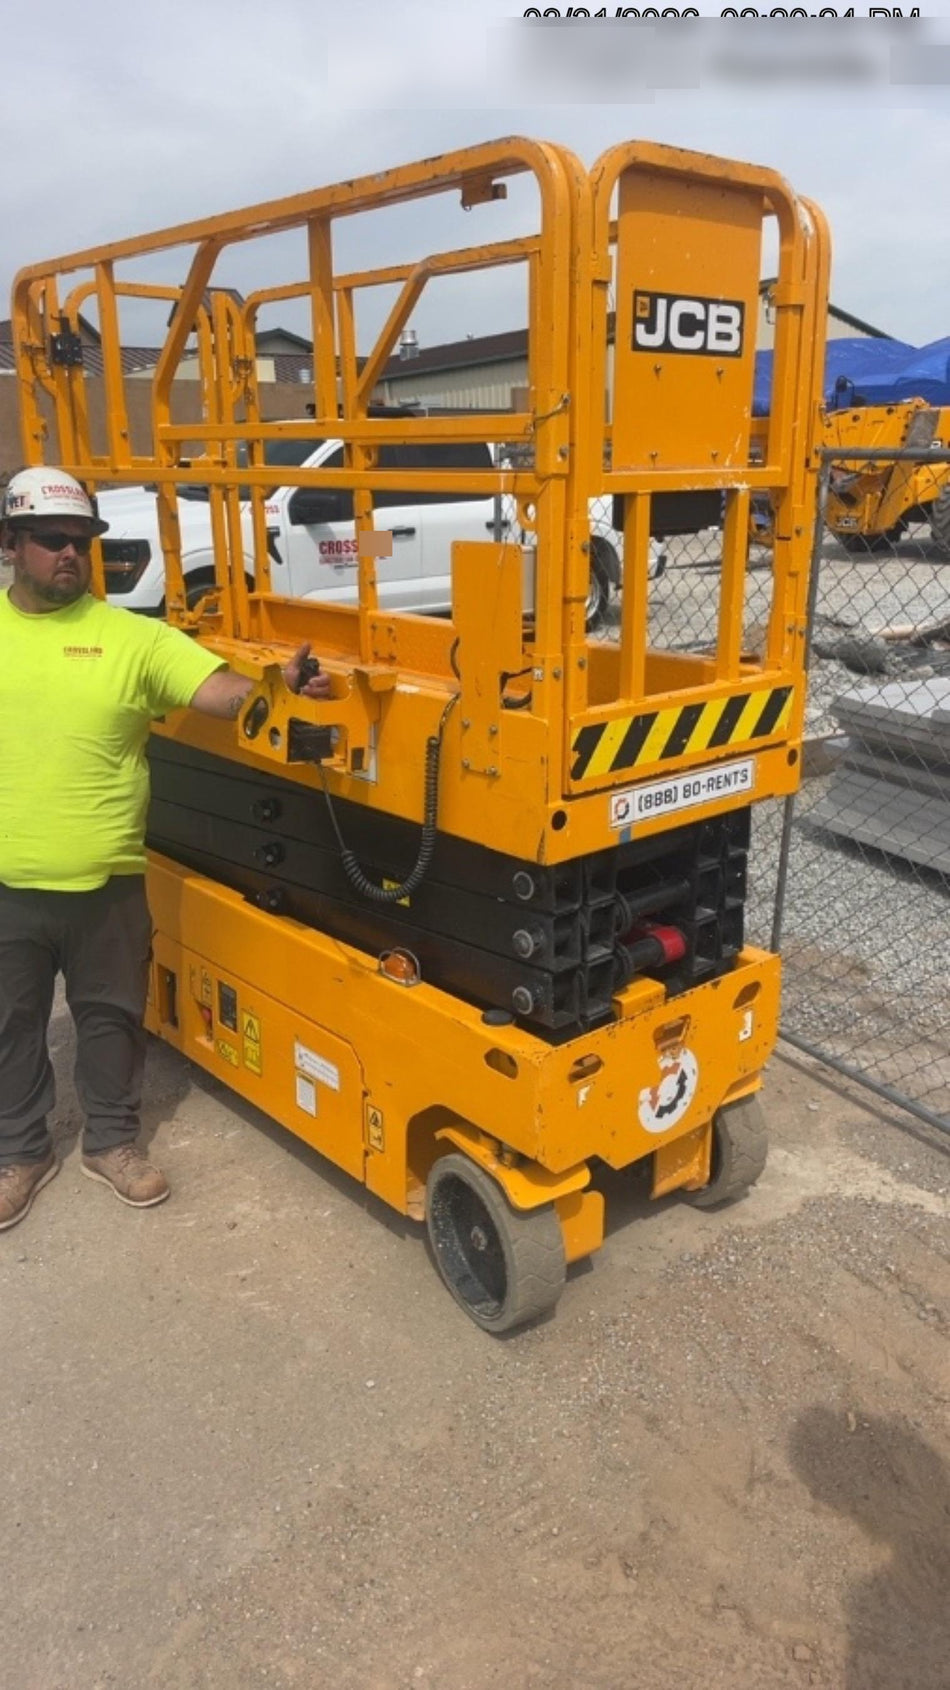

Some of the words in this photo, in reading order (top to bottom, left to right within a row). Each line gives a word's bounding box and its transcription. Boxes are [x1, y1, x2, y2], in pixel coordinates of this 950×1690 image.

[635, 298, 741, 352] JCB
[318, 540, 360, 555] CROSS
[638, 786, 679, 812] (888)
[683, 769, 749, 799] 80-RENTS
